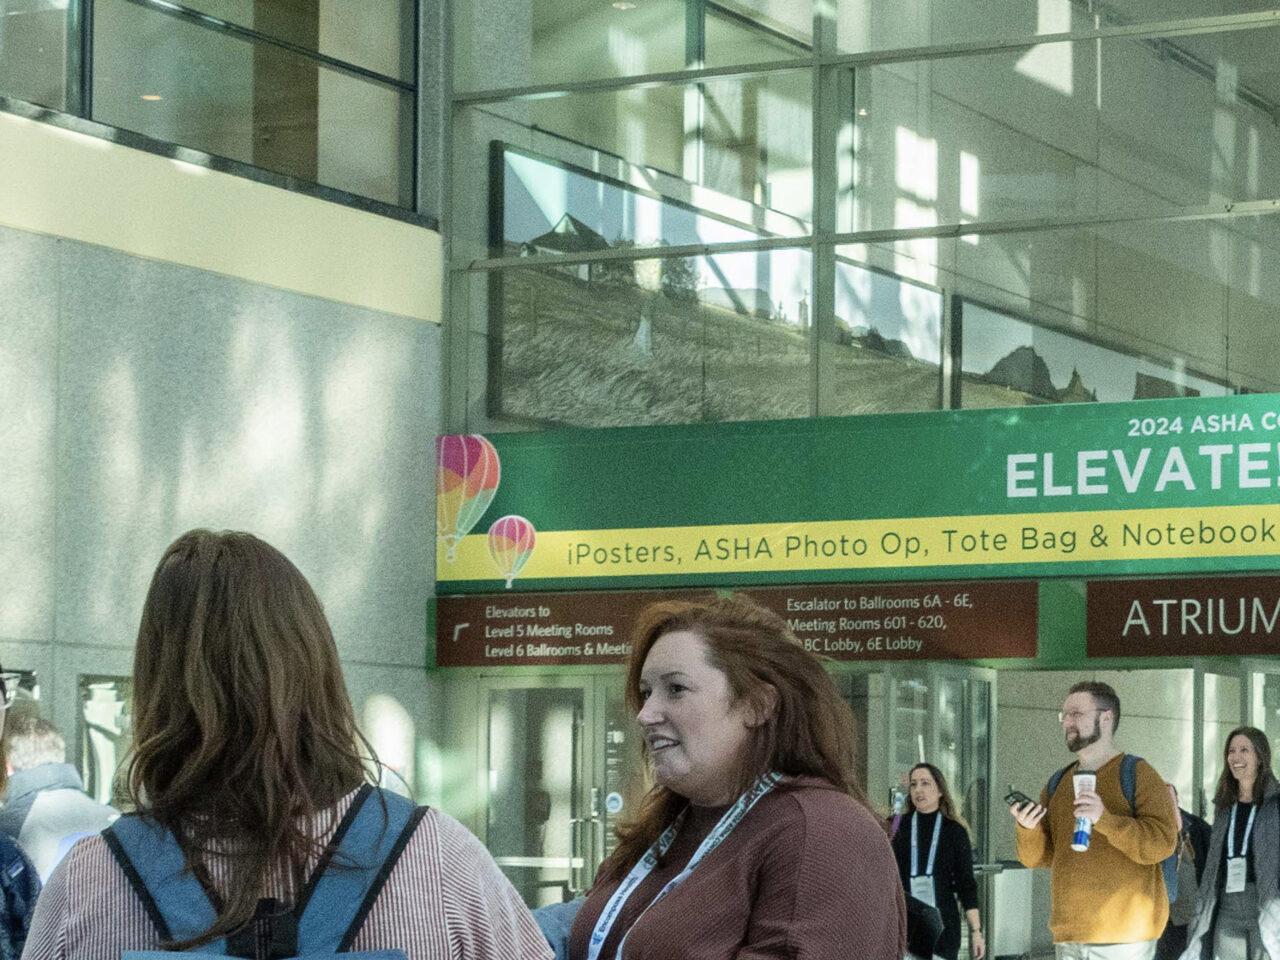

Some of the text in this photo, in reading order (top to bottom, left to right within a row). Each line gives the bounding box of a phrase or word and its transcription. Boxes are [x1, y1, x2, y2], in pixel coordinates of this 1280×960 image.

[1127, 418, 1184, 437] 2024
[1190, 413, 1254, 434] ASHA
[567, 543, 682, 565] iPosters,
[694, 537, 773, 561] ASHA
[785, 533, 868, 558] Photo
[881, 532, 929, 558] Op,
[942, 529, 1008, 553] Tote
[1021, 527, 1077, 554] Bag
[1090, 524, 1109, 548] &
[1122, 518, 1276, 547] Notebook
[786, 597, 840, 611] Escalator
[844, 598, 857, 610] to
[860, 596, 920, 610] Ballrooms
[922, 594, 942, 609] 6A
[953, 593, 973, 609] 6E,
[485, 605, 550, 618] Elevators to
[485, 623, 613, 639] Level 5 Meeting Rooms
[786, 618, 836, 633] Meeting
[839, 617, 881, 631] Rooms
[883, 616, 906, 630] 601
[917, 615, 947, 630] 620,
[485, 644, 514, 657] Level
[516, 644, 524, 657] 6
[527, 643, 582, 657] Ballrooms
[584, 643, 594, 656] &
[803, 636, 923, 653] BC Lobby, 6E Lobby
